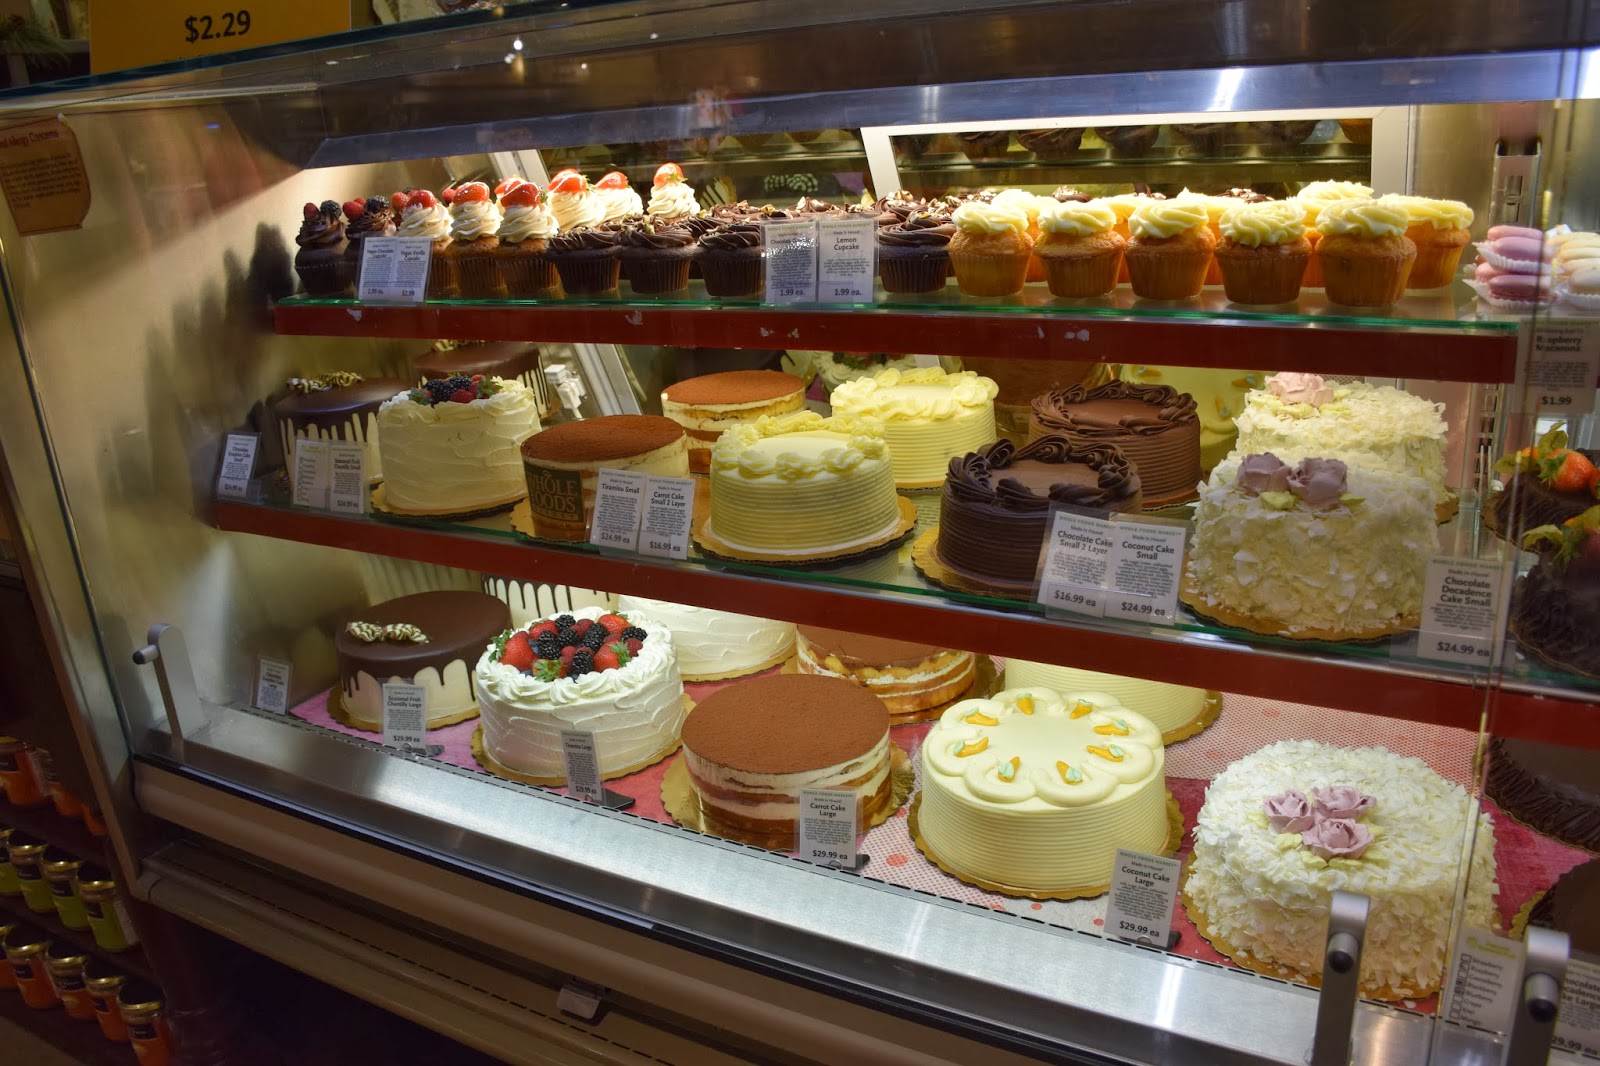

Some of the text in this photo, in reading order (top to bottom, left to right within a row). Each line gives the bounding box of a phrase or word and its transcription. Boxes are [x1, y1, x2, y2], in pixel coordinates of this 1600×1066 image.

[185, 10, 251, 43] $2.29
[834, 288, 849, 296] 1.99
[1536, 335, 1582, 345] Rspberry
[1541, 396, 1572, 405] $1.99
[527, 470, 578, 497] WHOLE
[602, 483, 624, 491] Tiramisu
[671, 500, 686, 508] Layer
[601, 532, 621, 542] $24.99
[1057, 530, 1113, 548] Chocolate Cake
[650, 541, 671, 551] $16.99
[1059, 539, 1080, 549] Small
[1088, 545, 1107, 555] Layer
[1122, 541, 1175, 554] Coconut Cake
[1136, 551, 1158, 560] Small
[1444, 576, 1490, 589] Chocolate
[1441, 585, 1492, 598] Decadence
[1054, 590, 1096, 607] $16.99 ea
[1440, 594, 1491, 607] Cake Small
[1121, 601, 1165, 616] $24.99 ea
[1437, 641, 1490, 657] $24.99 ea
[810, 802, 829, 810] Carrot
[819, 810, 836, 818] Large
[812, 849, 837, 859] $29.99
[1121, 865, 1170, 883] Coconut Cake
[1135, 876, 1154, 887] Large
[1119, 920, 1160, 937] $29.99 ea
